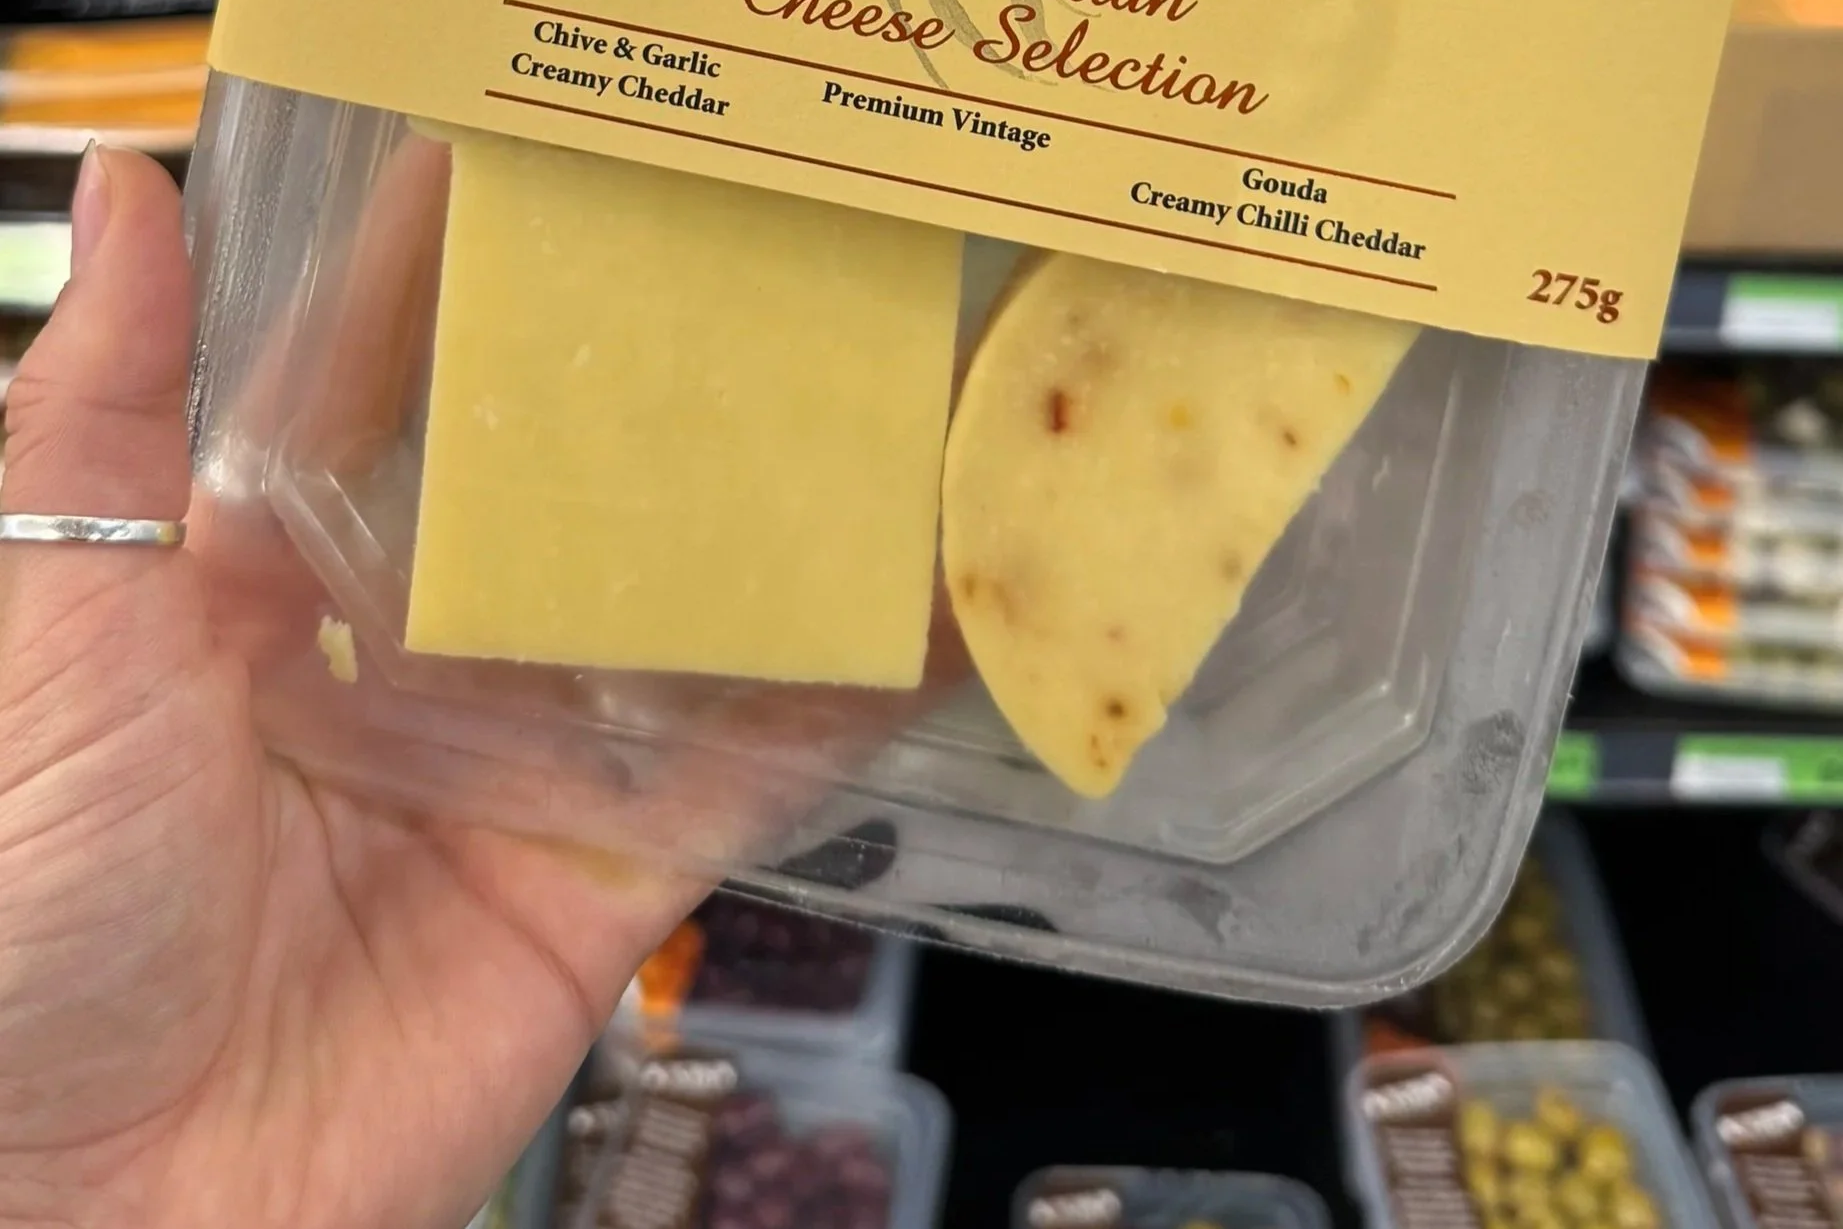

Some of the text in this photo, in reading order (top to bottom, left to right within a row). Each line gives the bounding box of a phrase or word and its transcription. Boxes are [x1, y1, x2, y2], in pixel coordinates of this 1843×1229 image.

[533, 20, 722, 78] Chive & Garlic
[972, 3, 1269, 115] Selection
[511, 52, 731, 117] Creamy Cheddar
[821, 80, 1052, 152] Premium Vintage
[1242, 167, 1328, 205] Gouda
[1130, 181, 1427, 260] Creamy Chilli Cheddar
[1527, 269, 1623, 324] 275g
